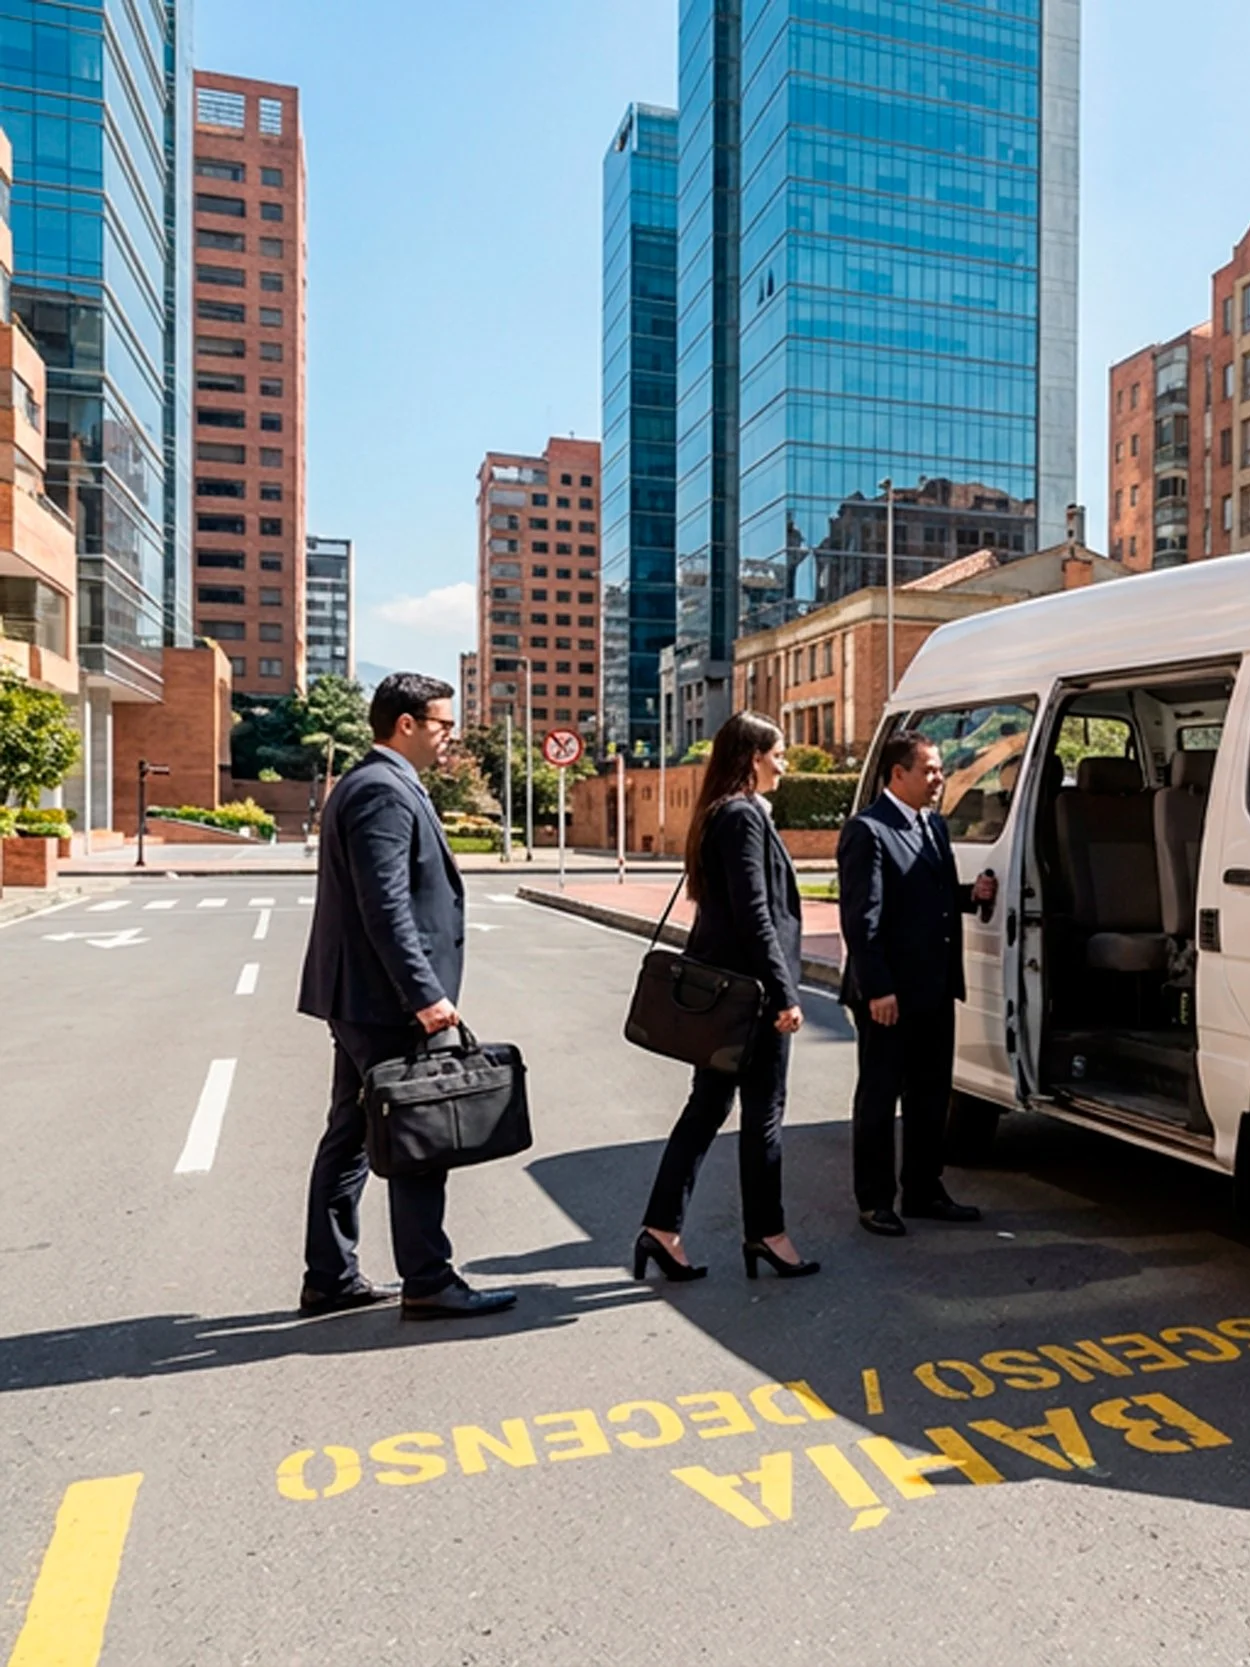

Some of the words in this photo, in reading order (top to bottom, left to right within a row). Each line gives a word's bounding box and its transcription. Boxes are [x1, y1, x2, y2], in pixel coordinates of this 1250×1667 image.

[275, 1379, 839, 1501] DECENSO
[861, 1367, 885, 1416] /
[670, 1391, 1233, 1532] BAHÍA
